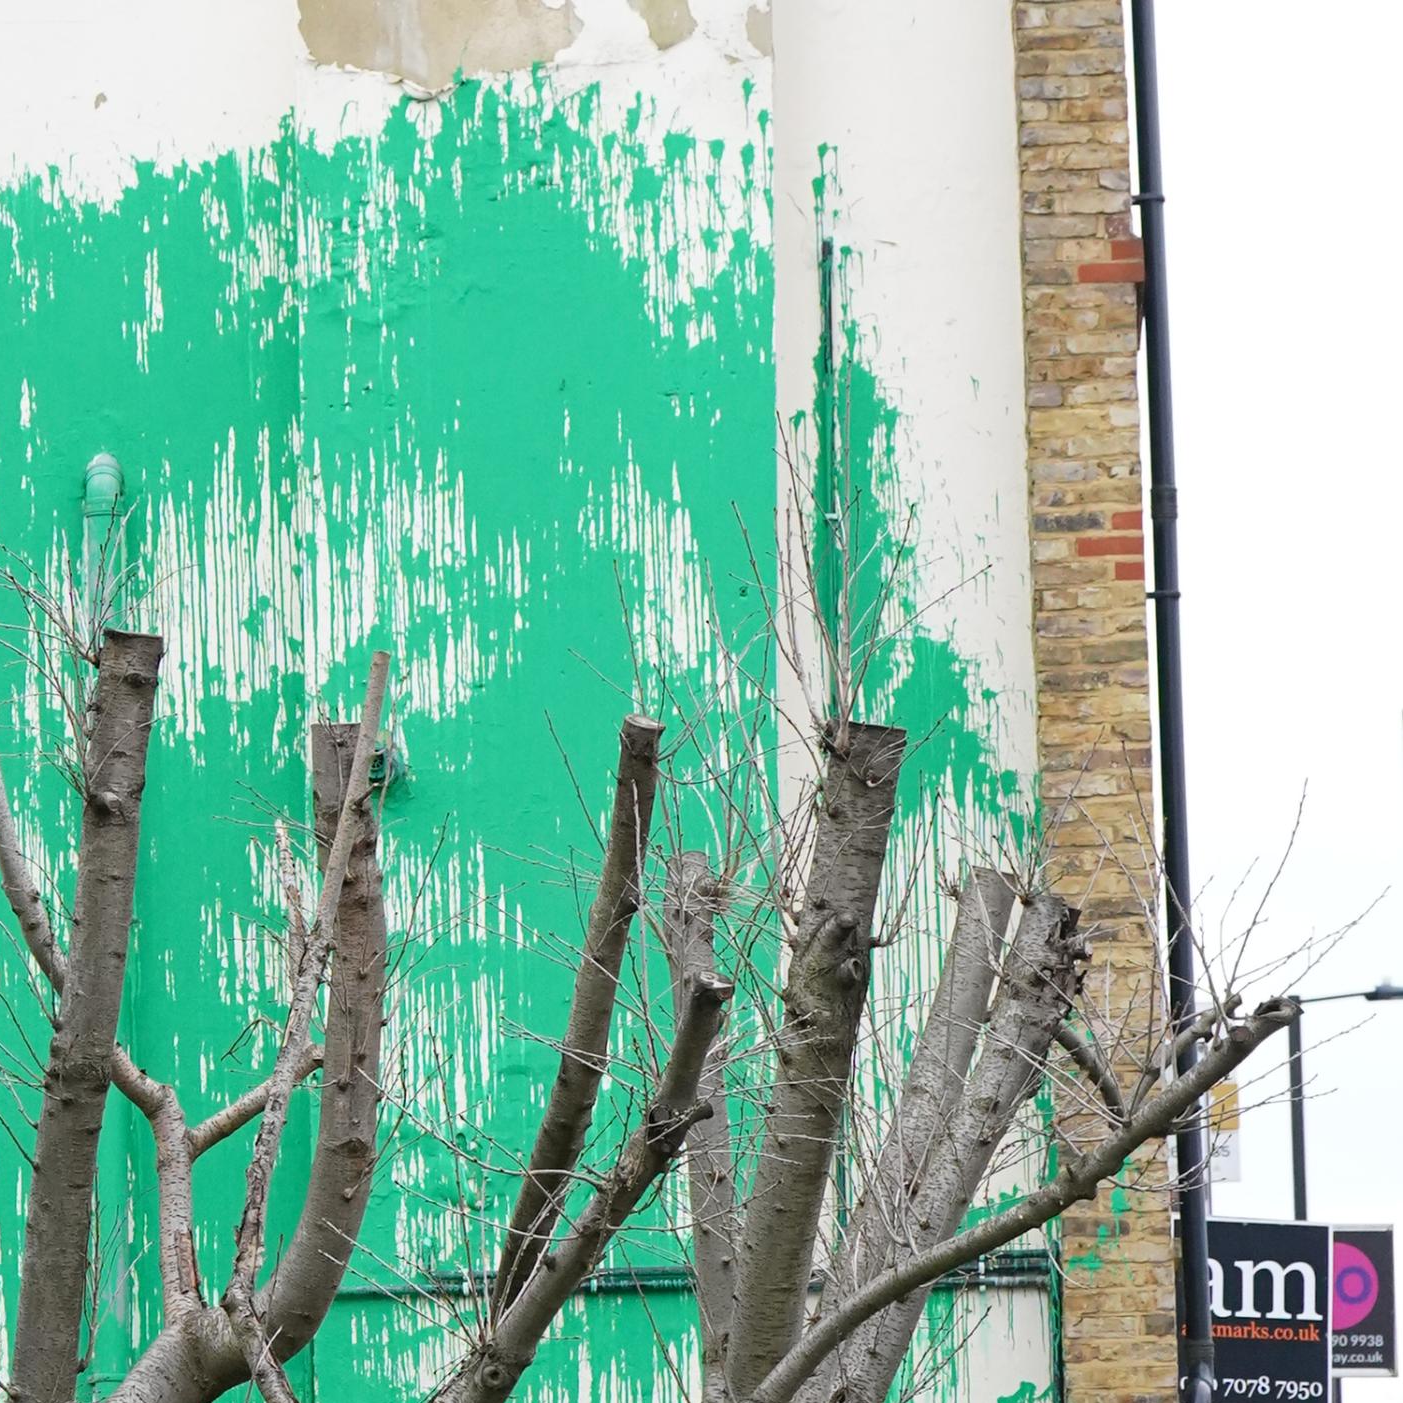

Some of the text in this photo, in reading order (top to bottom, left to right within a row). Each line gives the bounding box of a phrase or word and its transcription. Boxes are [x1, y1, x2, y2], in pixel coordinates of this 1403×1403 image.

[1350, 1334, 1384, 1347] 9938
[1332, 1351, 1383, 1365] ay.co.uk
[1222, 1375, 1271, 1398] 7078
[1275, 1381, 1323, 1400] 7950
